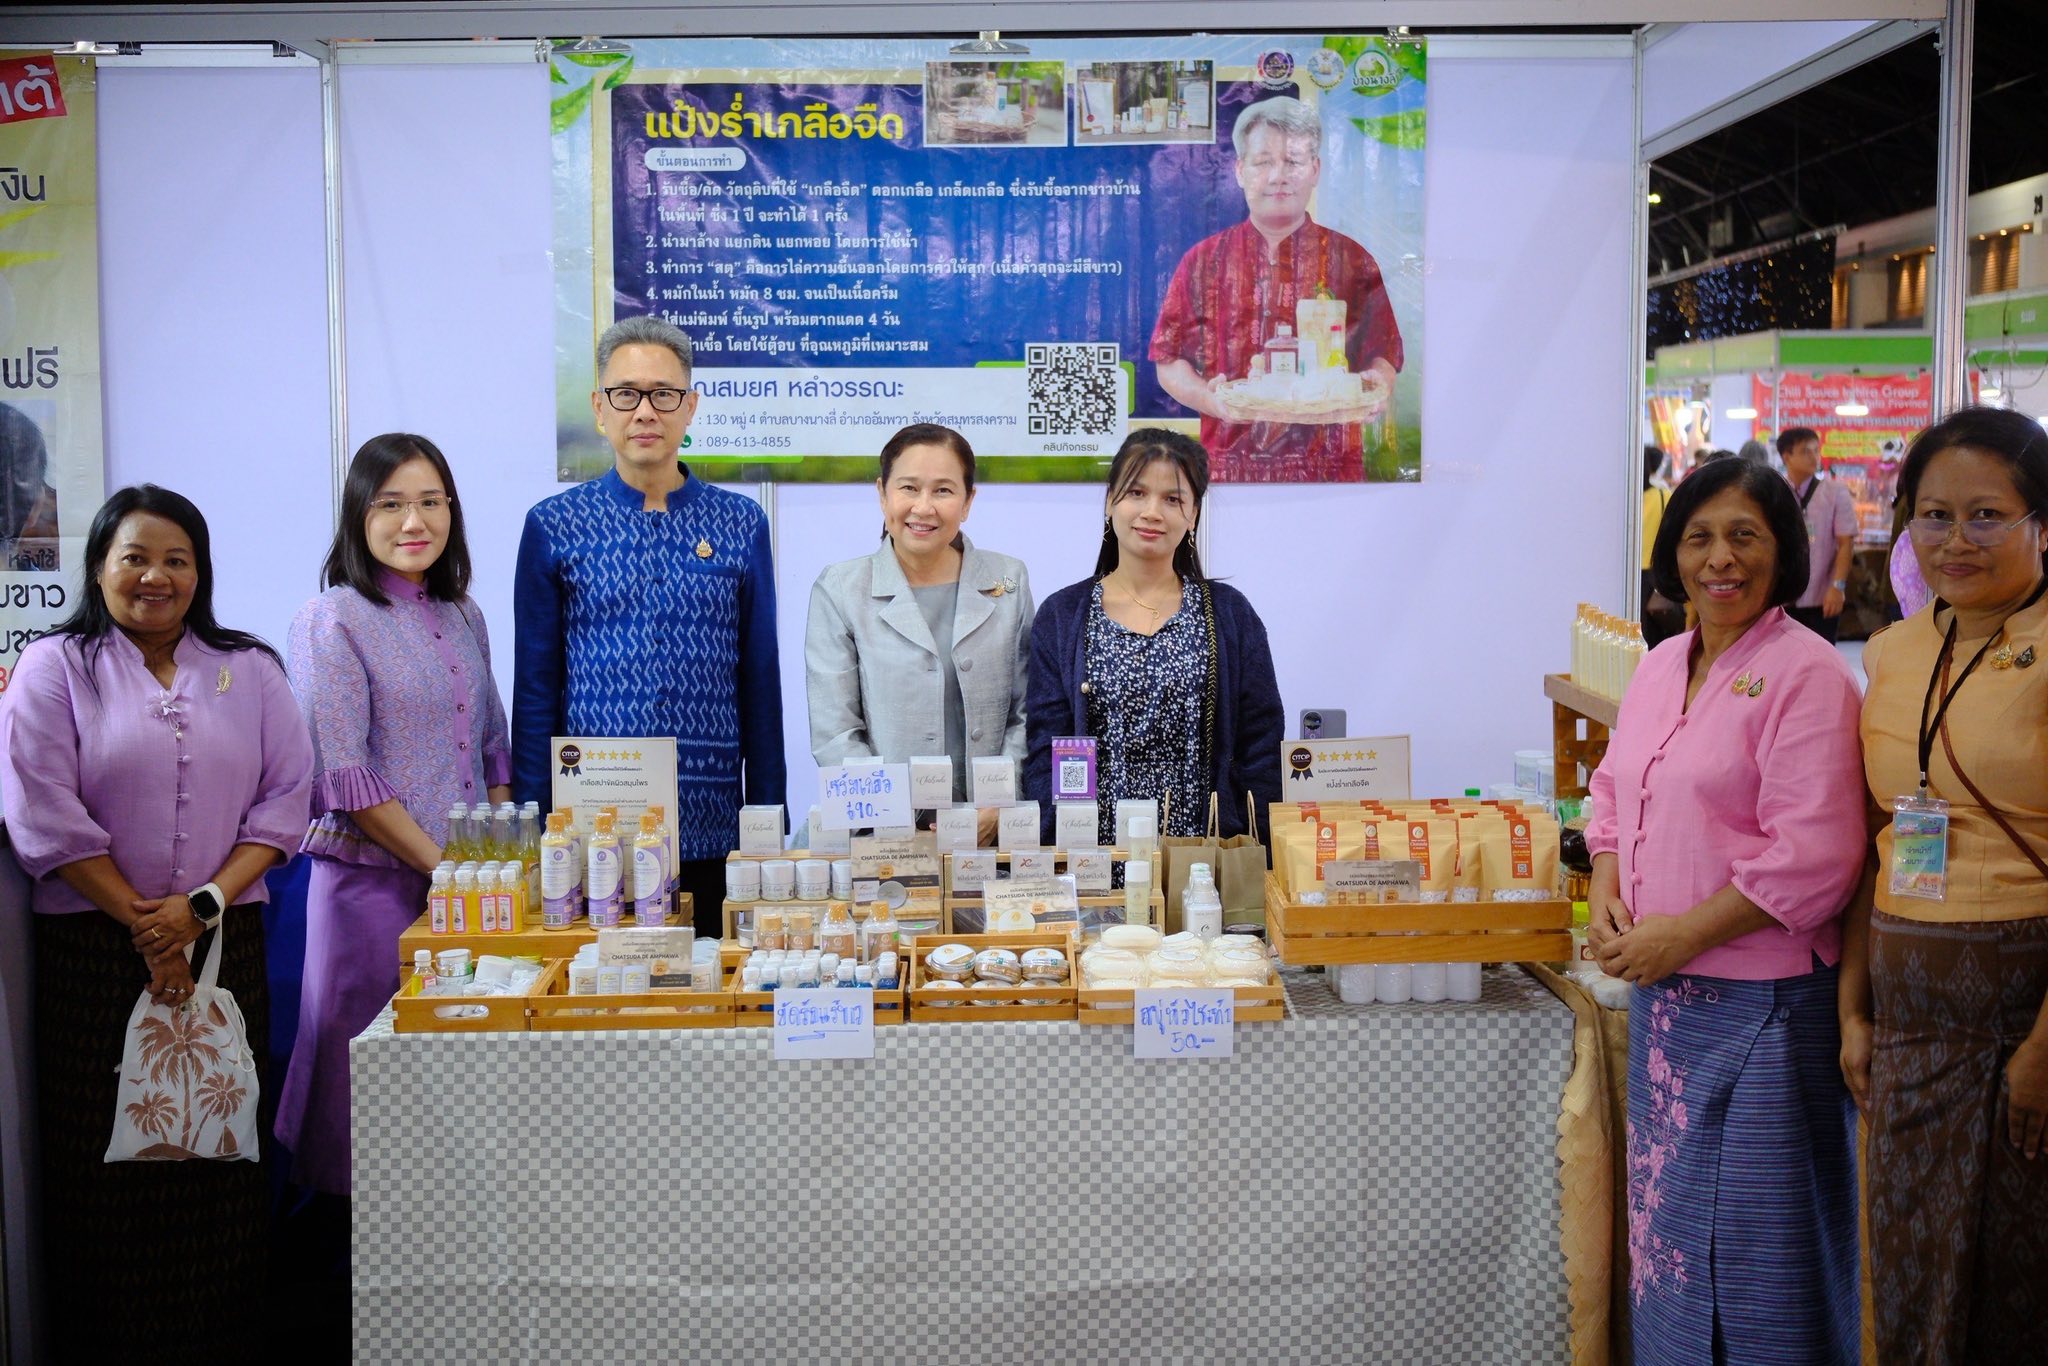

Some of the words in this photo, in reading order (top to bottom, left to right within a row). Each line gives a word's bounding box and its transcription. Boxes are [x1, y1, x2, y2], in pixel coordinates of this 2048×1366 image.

[645, 92, 904, 139] แป้งร่ำเกลือจืด
[656, 151, 732, 167] ขั้นตอนการทำ
[646, 184, 657, 196] 1.
[662, 176, 722, 196] รับซื้อ/คัด
[726, 176, 797, 200] วัตถุดิบที่ใช้
[872, 182, 933, 197] ดอกเกลือ
[939, 181, 1005, 197] เกล็ดเกลือ
[1009, 176, 1141, 197] ซึ่งรับซื้อจากชาวบ้าน
[658, 203, 705, 222] ในพื้นที่
[711, 205, 727, 222] ซึ่ง
[732, 209, 739, 221] 1
[743, 207, 754, 222] ปี
[758, 205, 807, 222] จะทำได้
[811, 209, 819, 221] 1
[825, 200, 849, 222] ครั้ง
[645, 236, 658, 248] 2.
[662, 232, 719, 248] นำมาล้าง
[725, 234, 771, 248] แยกดิน
[776, 236, 830, 248] แยกหอย
[835, 228, 918, 249] โดยการใช้น้ำ
[646, 262, 658, 274] 3.
[662, 259, 702, 274] ทำการ
[746, 255, 985, 278] คือการไล่ความชื้นออกโดยการคั่วให้สุก
[991, 254, 1123, 278] (เนื้อคั่วสุกจะมีสีขาว)
[646, 288, 658, 300] 4.
[662, 280, 725, 300] หมักในน้ำ
[729, 284, 759, 300] หมัก
[763, 288, 772, 300] 8
[776, 287, 800, 300] ชม.
[804, 280, 898, 300] จนเป็นเนื้อครีม
[662, 309, 728, 326] ใส่แม่พิมพ์
[732, 305, 768, 330] ขึ้นรูป
[773, 311, 863, 326] พร้อมตากแดด
[868, 314, 878, 326] 4
[882, 311, 900, 326] วัน
[689, 331, 722, 352] ่าเชื้อ
[726, 335, 796, 355] โดยใช้ตู้อบ
[800, 332, 928, 356] ที่อุณหภูมิที่เหมาะสม
[2, 346, 59, 389] ฟรี
[706, 414, 728, 425] 130
[730, 411, 747, 430] หมู่
[749, 414, 757, 425] 4
[759, 408, 837, 426] ตำบลบางนางลี่
[839, 411, 909, 426] อำเภออัมพวา
[911, 410, 1017, 431] จังหวัดสมุทรสงคราม
[706, 436, 792, 448] 089-613-4855
[1043, 442, 1099, 452] คลิปกิจกรรม
